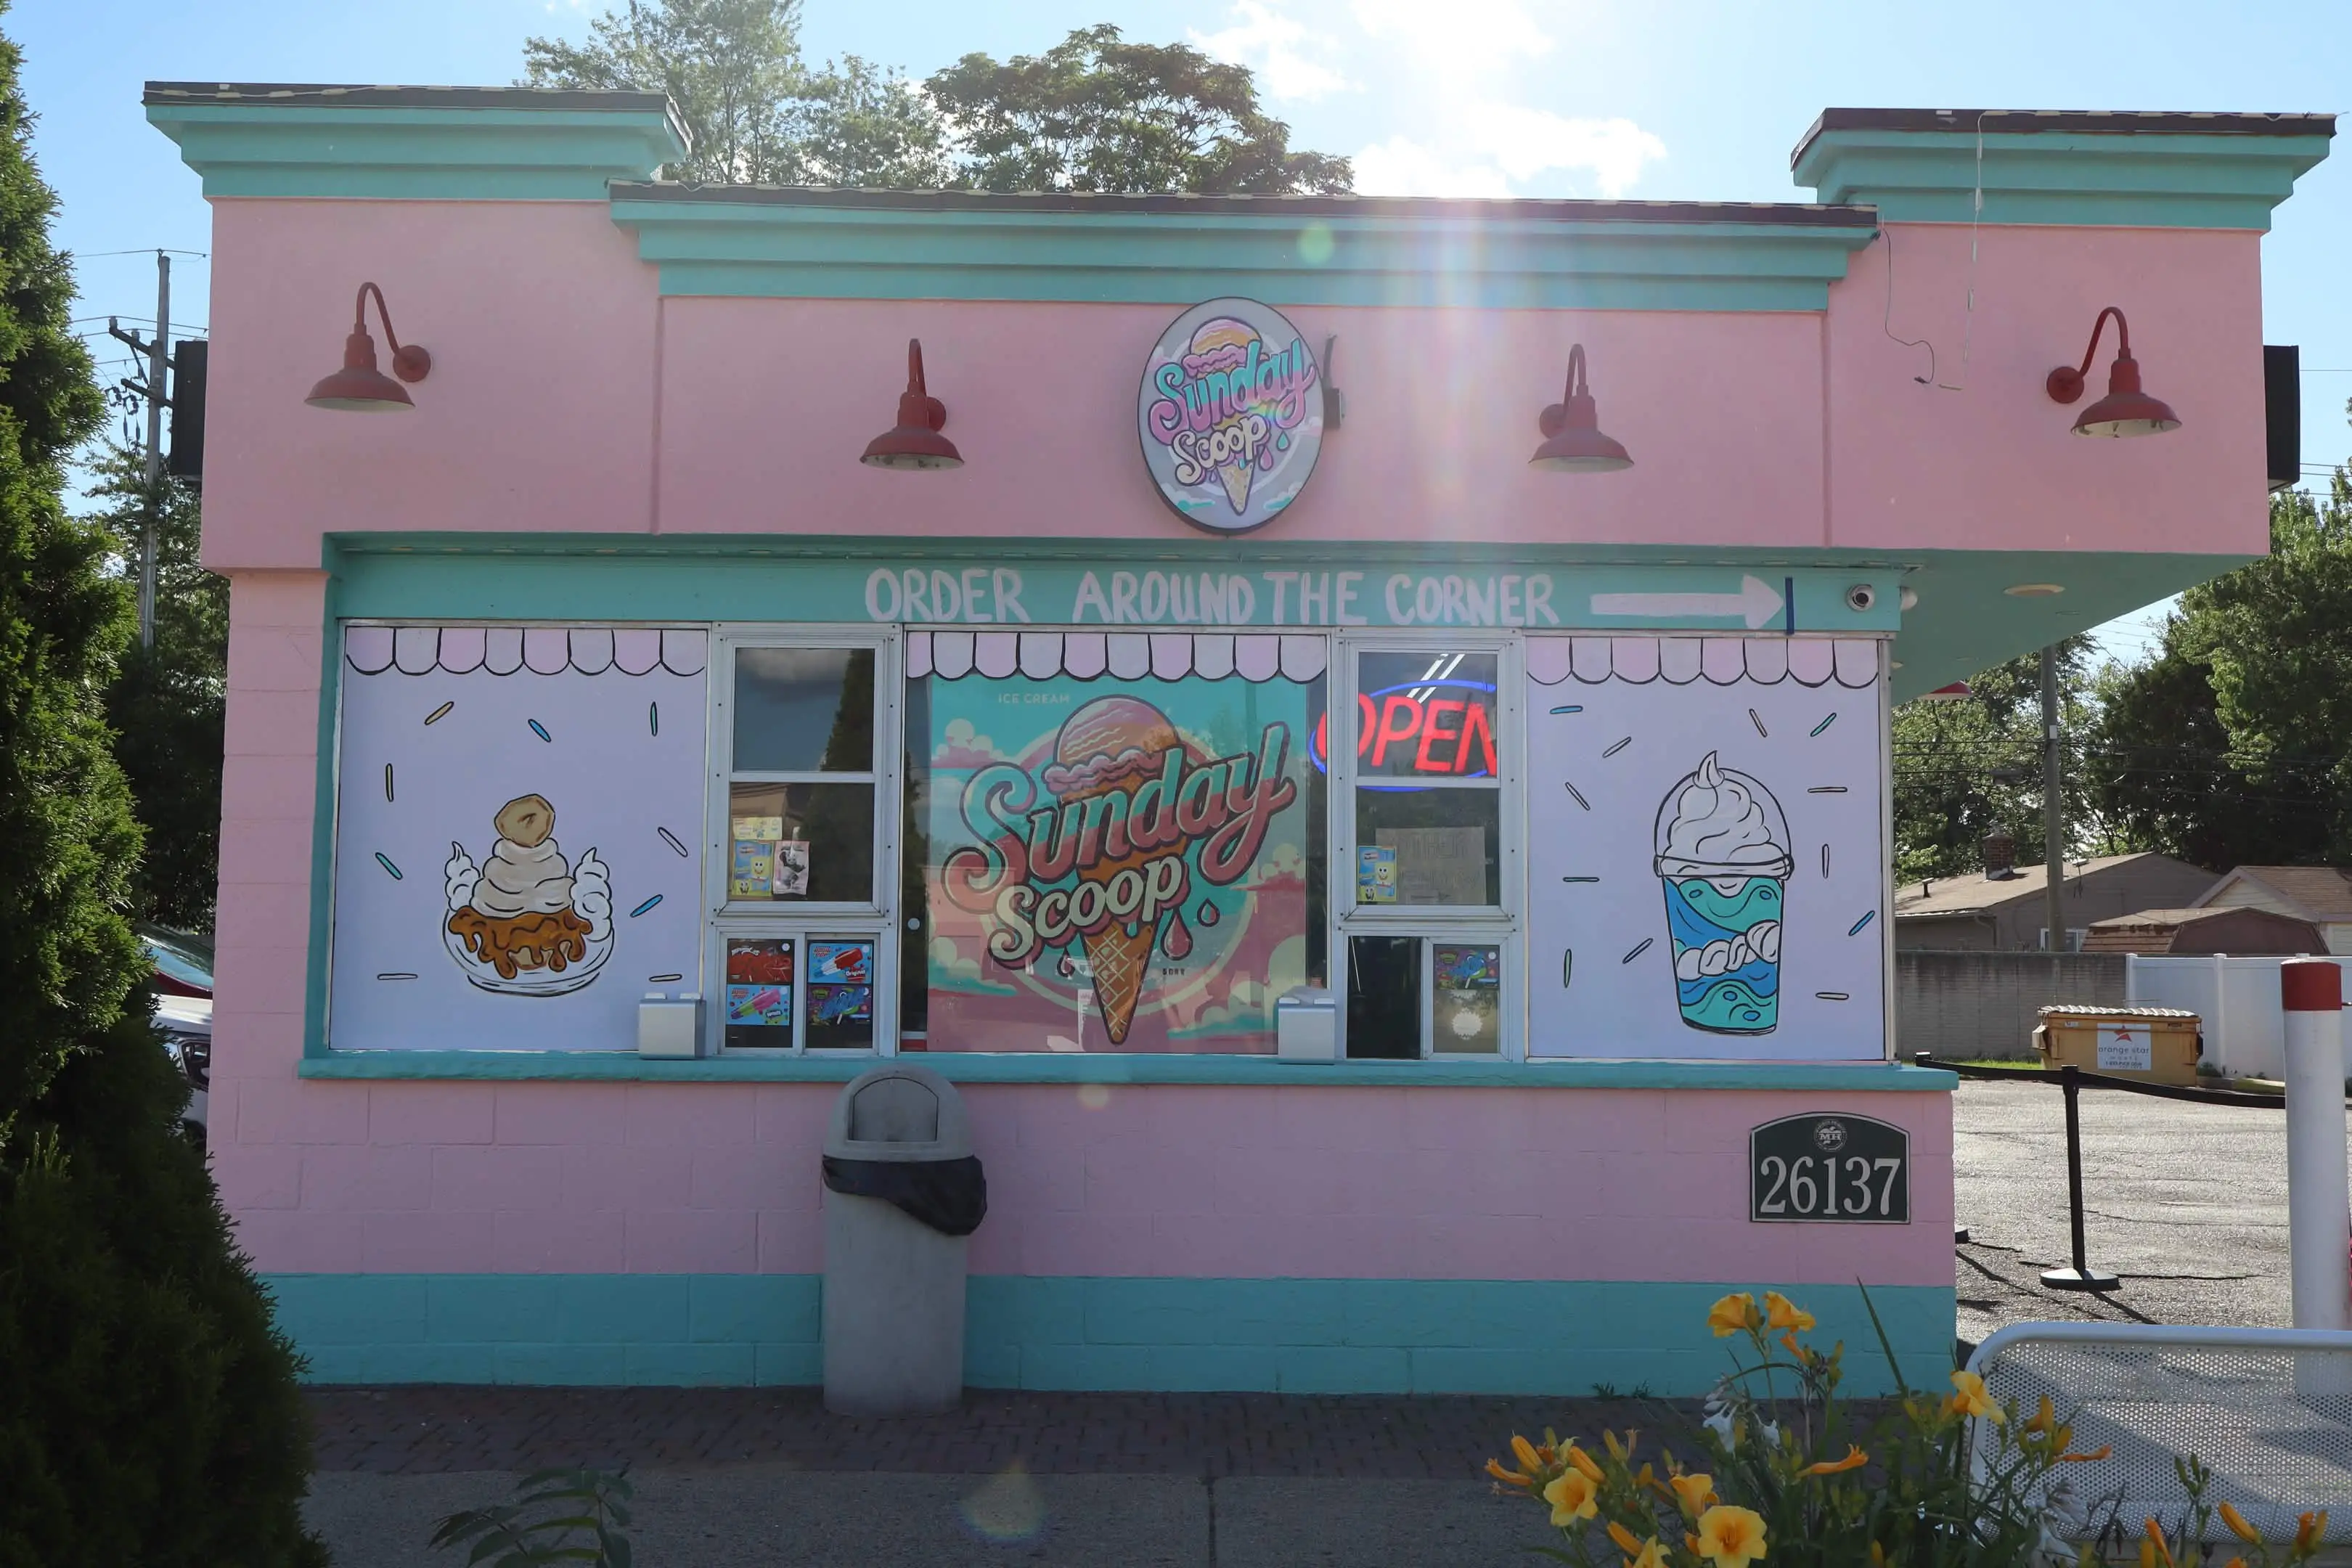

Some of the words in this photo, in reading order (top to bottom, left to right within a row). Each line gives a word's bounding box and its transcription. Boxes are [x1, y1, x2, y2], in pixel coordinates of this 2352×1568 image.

[1148, 338, 1316, 446] Sunday
[1172, 415, 1268, 486] Scoop
[865, 568, 1031, 623] ORDER
[1072, 571, 1256, 625] AROUND
[1263, 571, 1368, 626] THE
[1385, 573, 1560, 626] CORNER
[998, 693, 1020, 704] ICE
[1024, 693, 1071, 704] CREAM
[1317, 693, 1497, 776] OPEN
[942, 722, 1297, 913] Sunday
[987, 852, 1189, 969] Scoop
[1760, 1156, 1901, 1216] 26137
